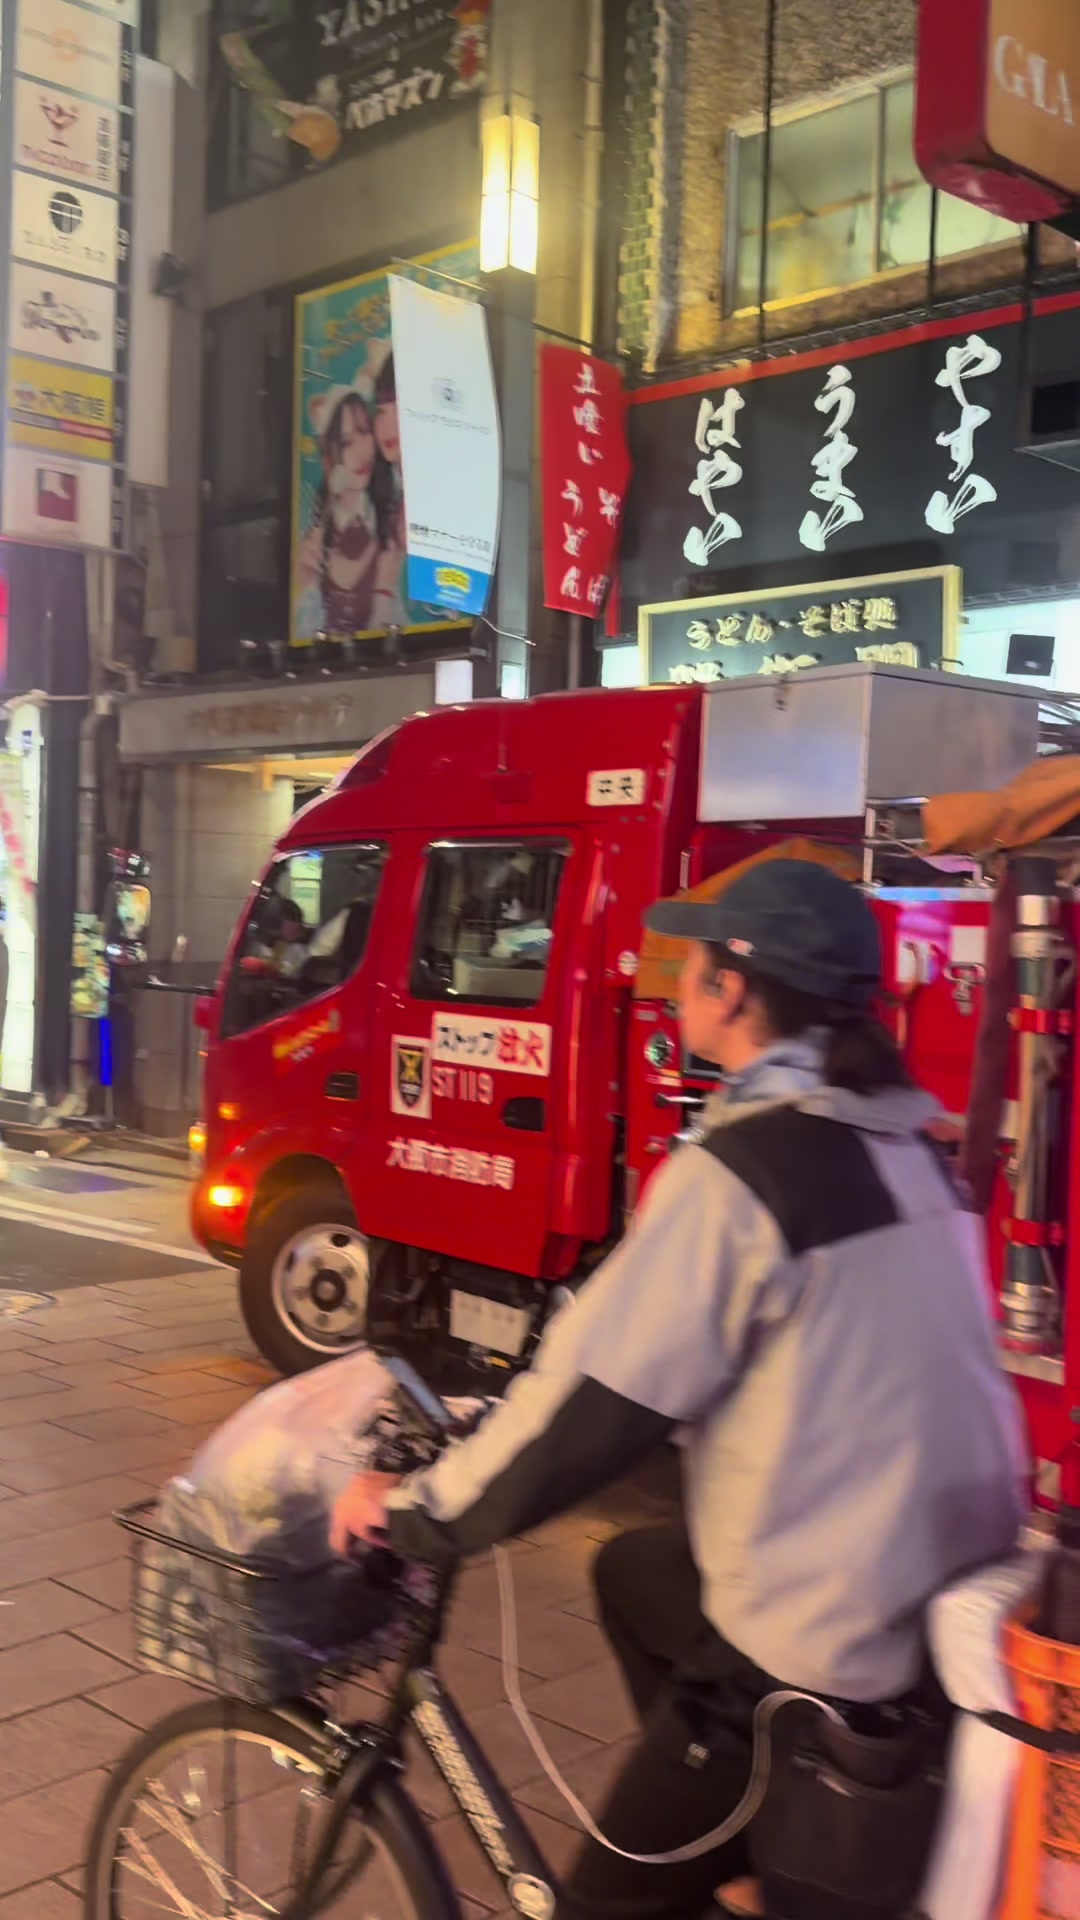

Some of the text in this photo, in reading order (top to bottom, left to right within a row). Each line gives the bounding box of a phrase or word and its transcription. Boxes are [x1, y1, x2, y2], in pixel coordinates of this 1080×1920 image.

[683, 387, 745, 566] はやい
[799, 365, 864, 551] うまい
[925, 333, 1001, 534] やすい
